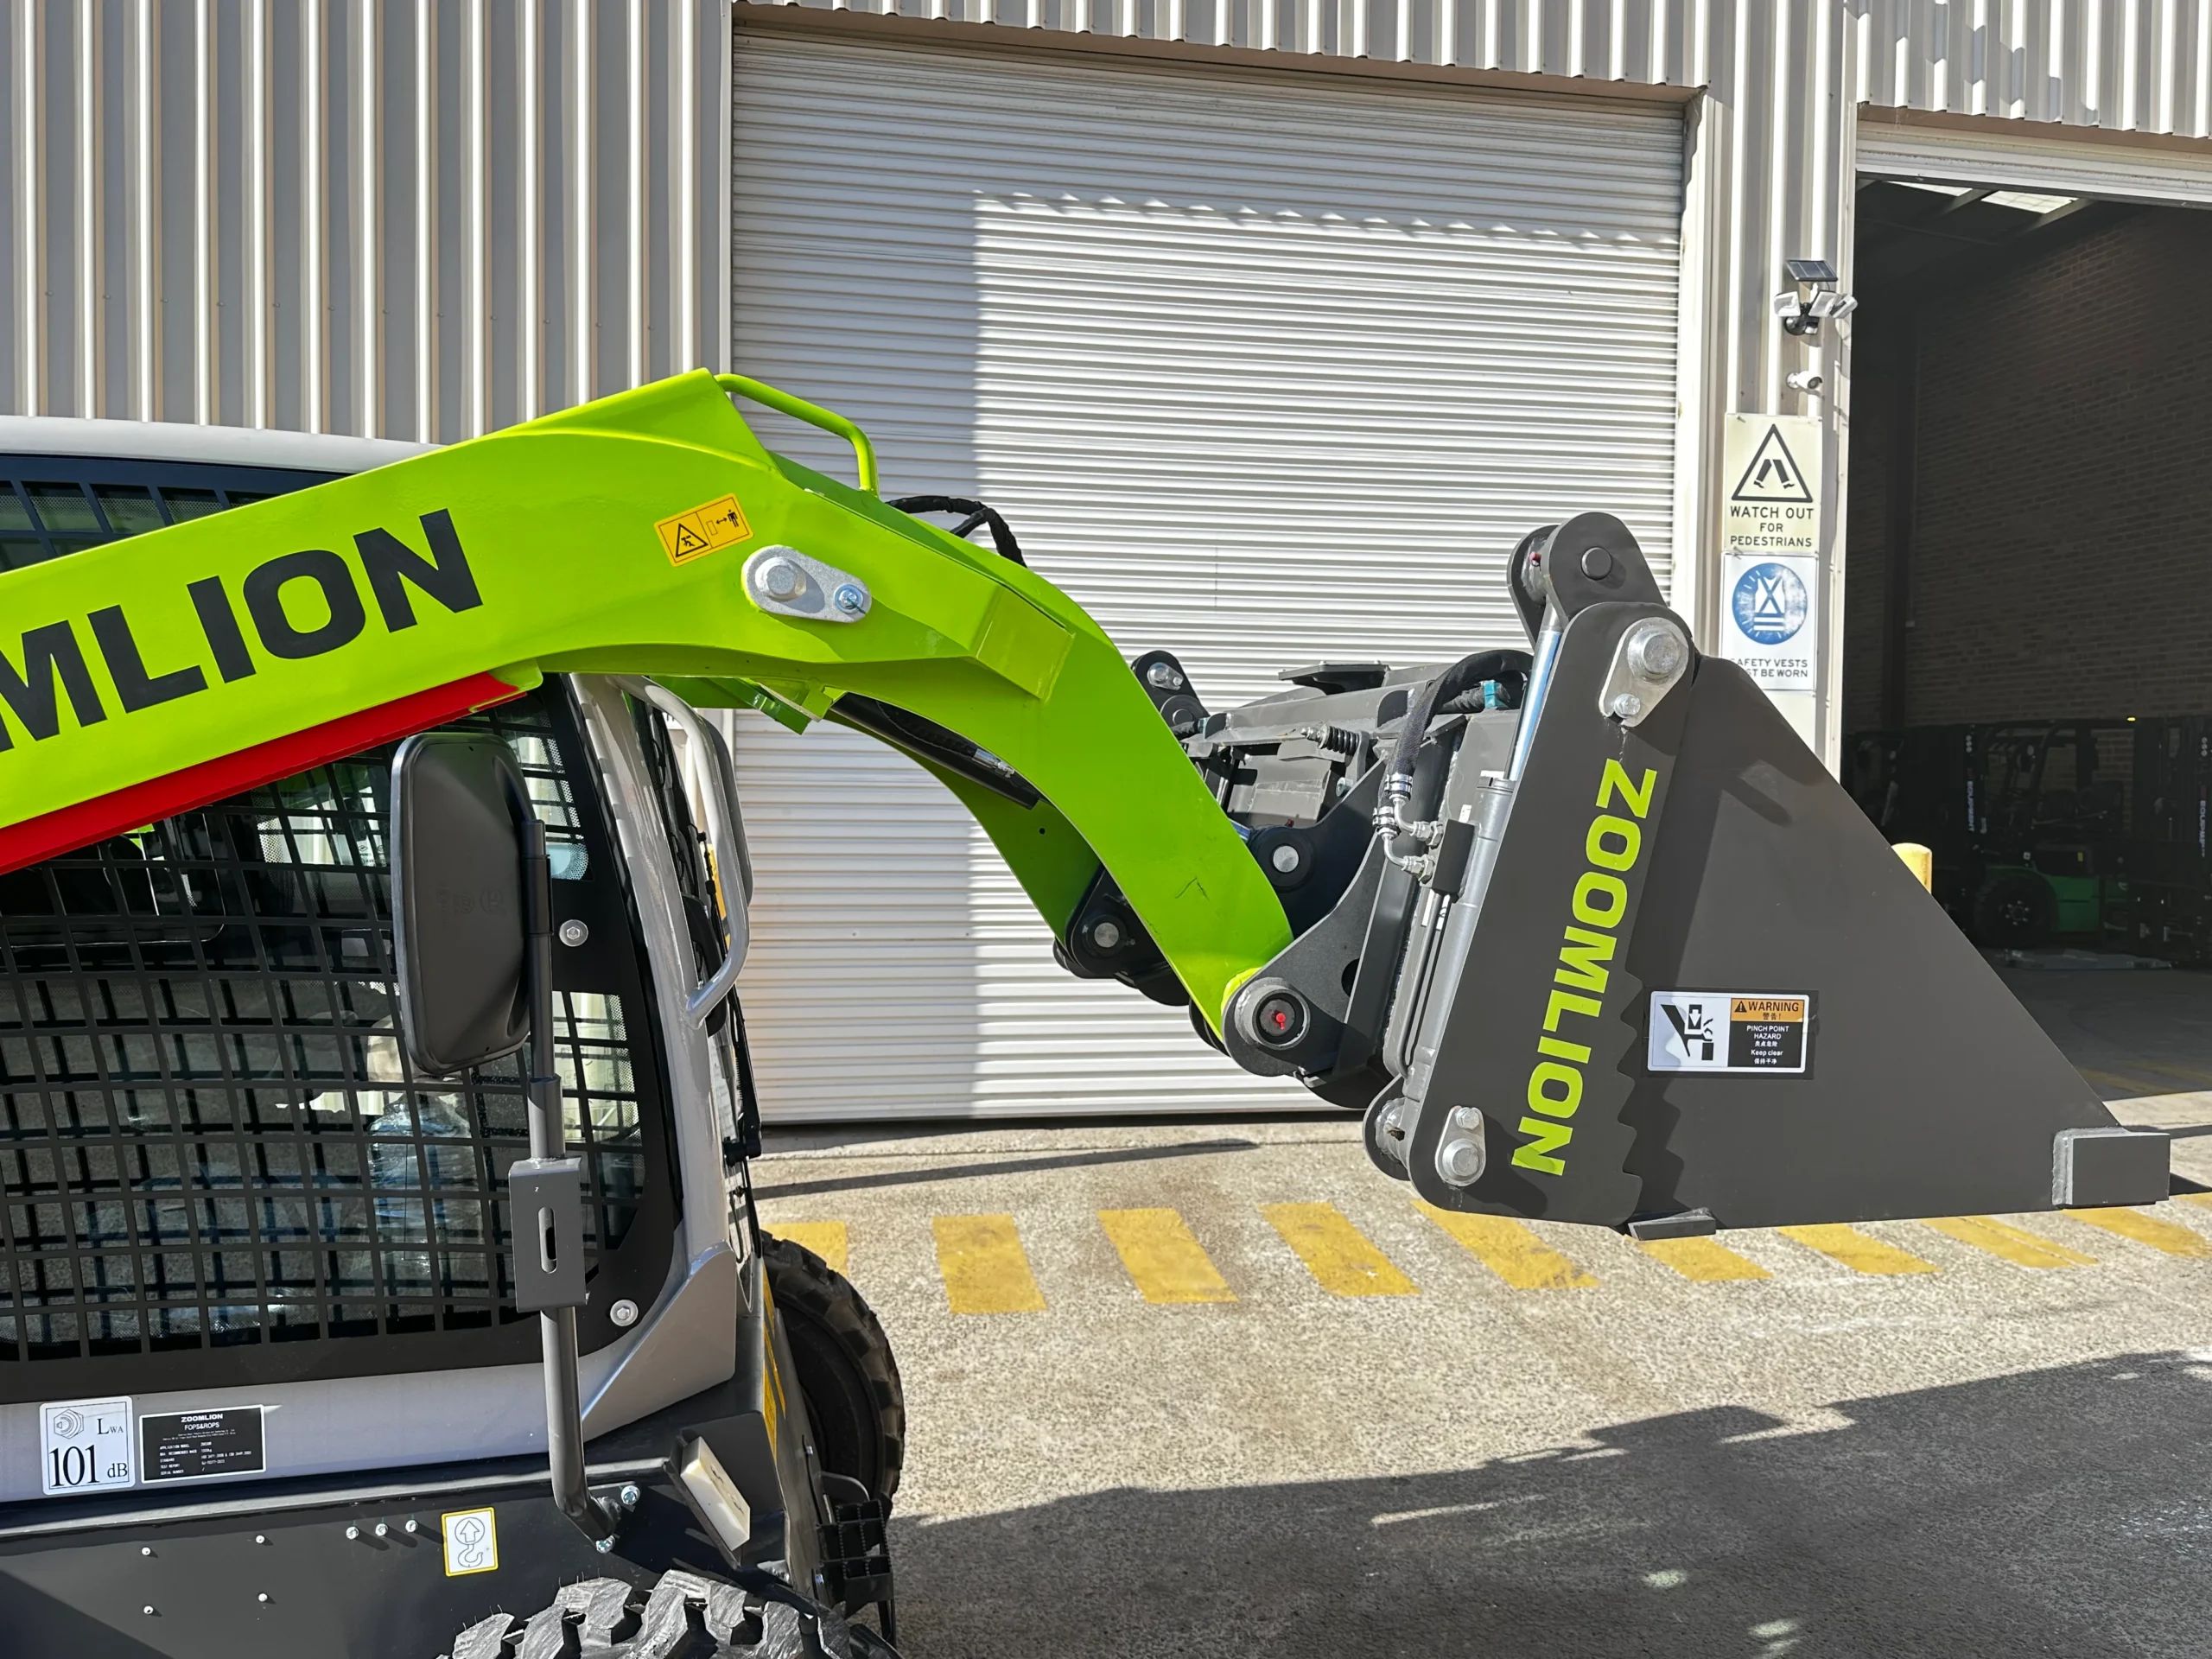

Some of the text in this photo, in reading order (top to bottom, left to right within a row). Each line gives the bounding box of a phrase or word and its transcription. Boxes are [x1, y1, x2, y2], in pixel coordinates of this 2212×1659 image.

[1730, 505, 1815, 519] WATCH OUT
[1759, 522, 1784, 532] FOR
[1730, 535, 1813, 548] PEDESTRIANS
[1730, 658, 1808, 668] AFETY VESTS
[1760, 669, 1775, 677] BE
[1777, 669, 1808, 677] WORN
[1511, 759, 1657, 1176] ZOOMLION
[1748, 1001, 1800, 1012] WARNING
[181, 1414, 224, 1423] ZOOMLION
[184, 1421, 220, 1431] FOPS&ROPS
[49, 1444, 100, 1487] 101
[106, 1462, 128, 1478] dB
